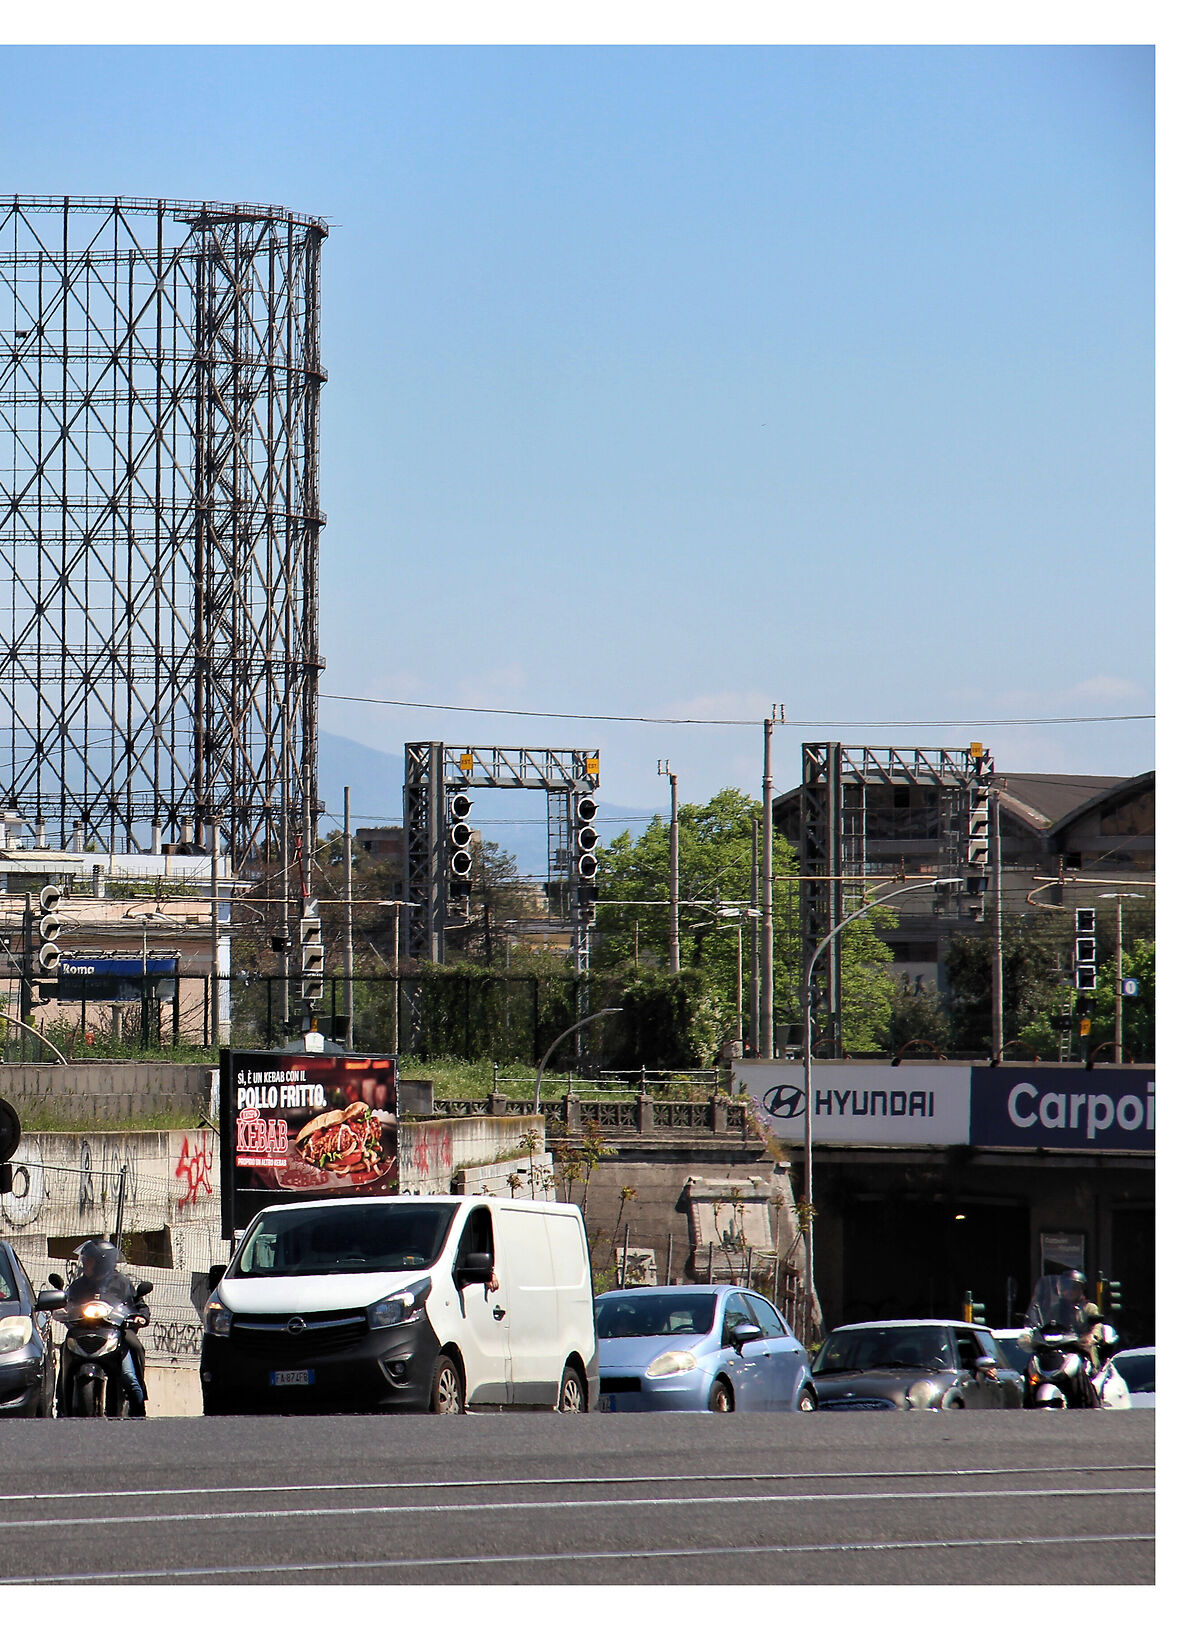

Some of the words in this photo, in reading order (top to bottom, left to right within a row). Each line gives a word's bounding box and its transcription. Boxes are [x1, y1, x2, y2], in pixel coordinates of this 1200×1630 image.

[63, 963, 95, 975] Roma
[247, 1070, 252, 1084] È
[253, 1072, 263, 1084] UN
[263, 1071, 285, 1083] KEBAB
[286, 1071, 300, 1082] CON
[300, 1070, 307, 1081] IL
[237, 1086, 278, 1109] POLLO
[280, 1084, 328, 1108] FRITTO.
[815, 1090, 935, 1117] HYUNDAI
[236, 1118, 289, 1153] KEBAB
